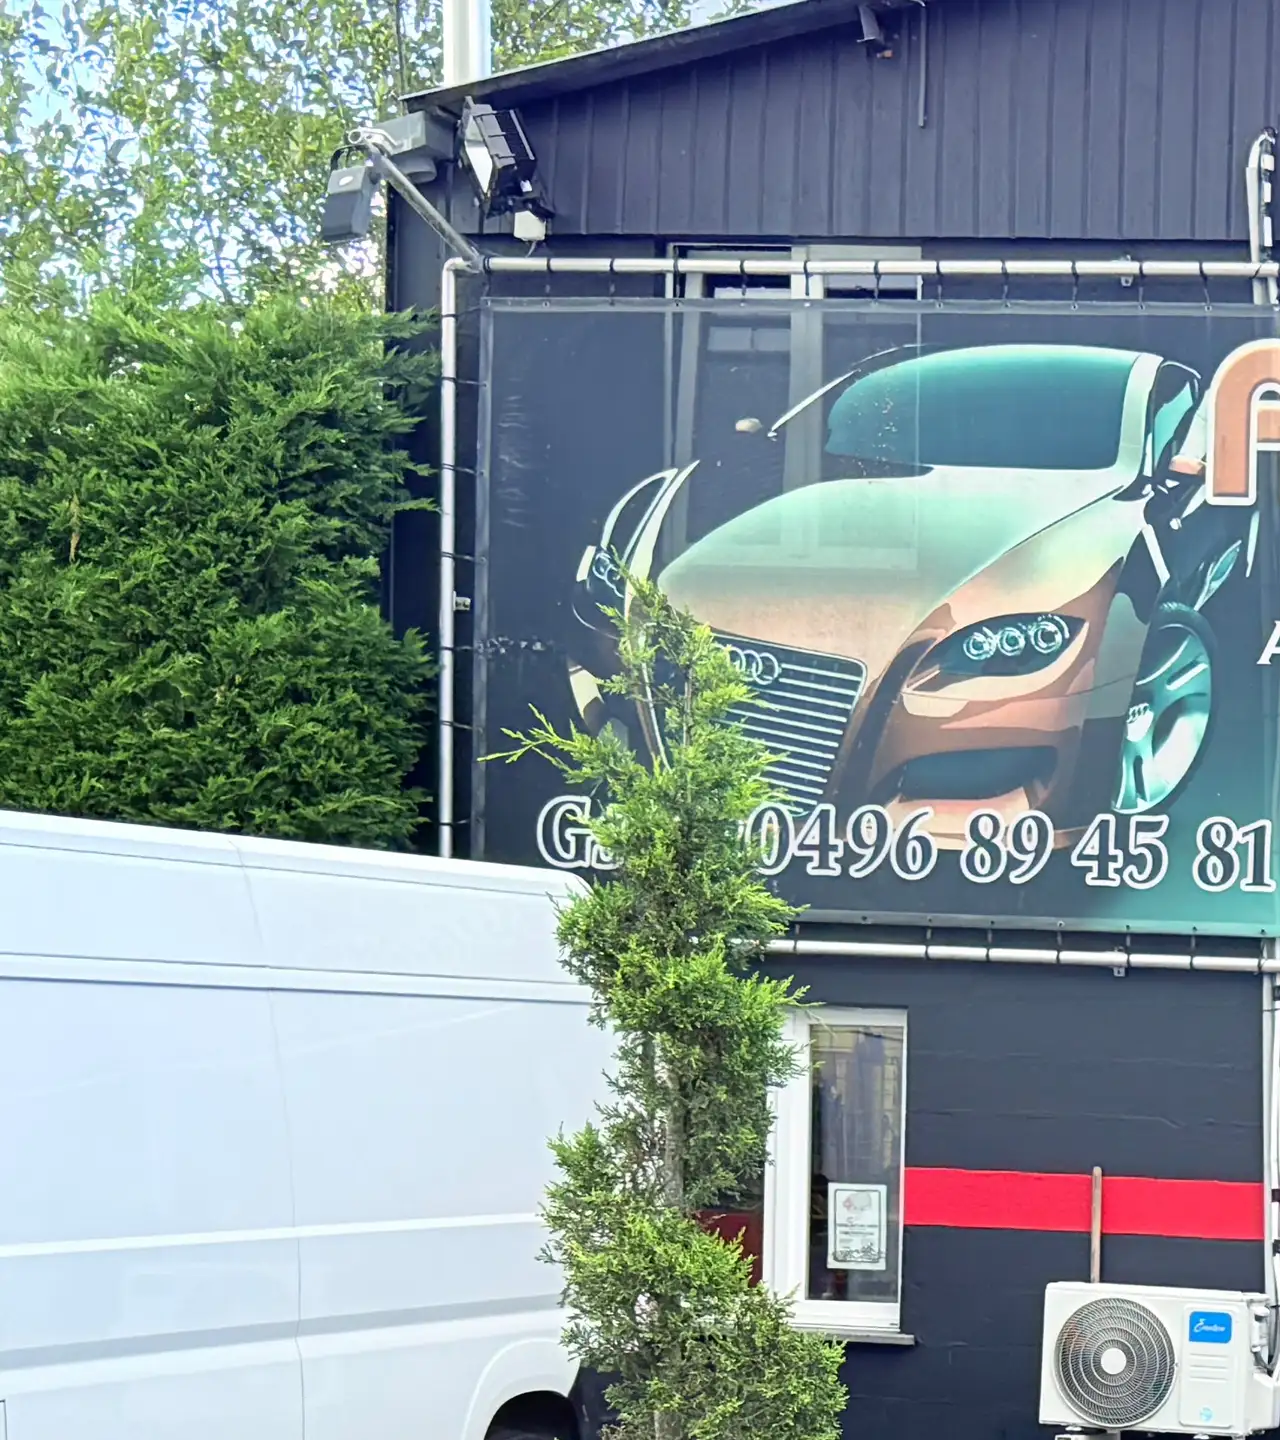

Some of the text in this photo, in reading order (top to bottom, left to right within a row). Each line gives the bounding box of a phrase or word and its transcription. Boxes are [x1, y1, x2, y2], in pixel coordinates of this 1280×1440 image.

[745, 802, 938, 881] 0496
[960, 808, 1054, 884] 89
[1070, 813, 1169, 890] 45
[1192, 815, 1277, 893] 81
